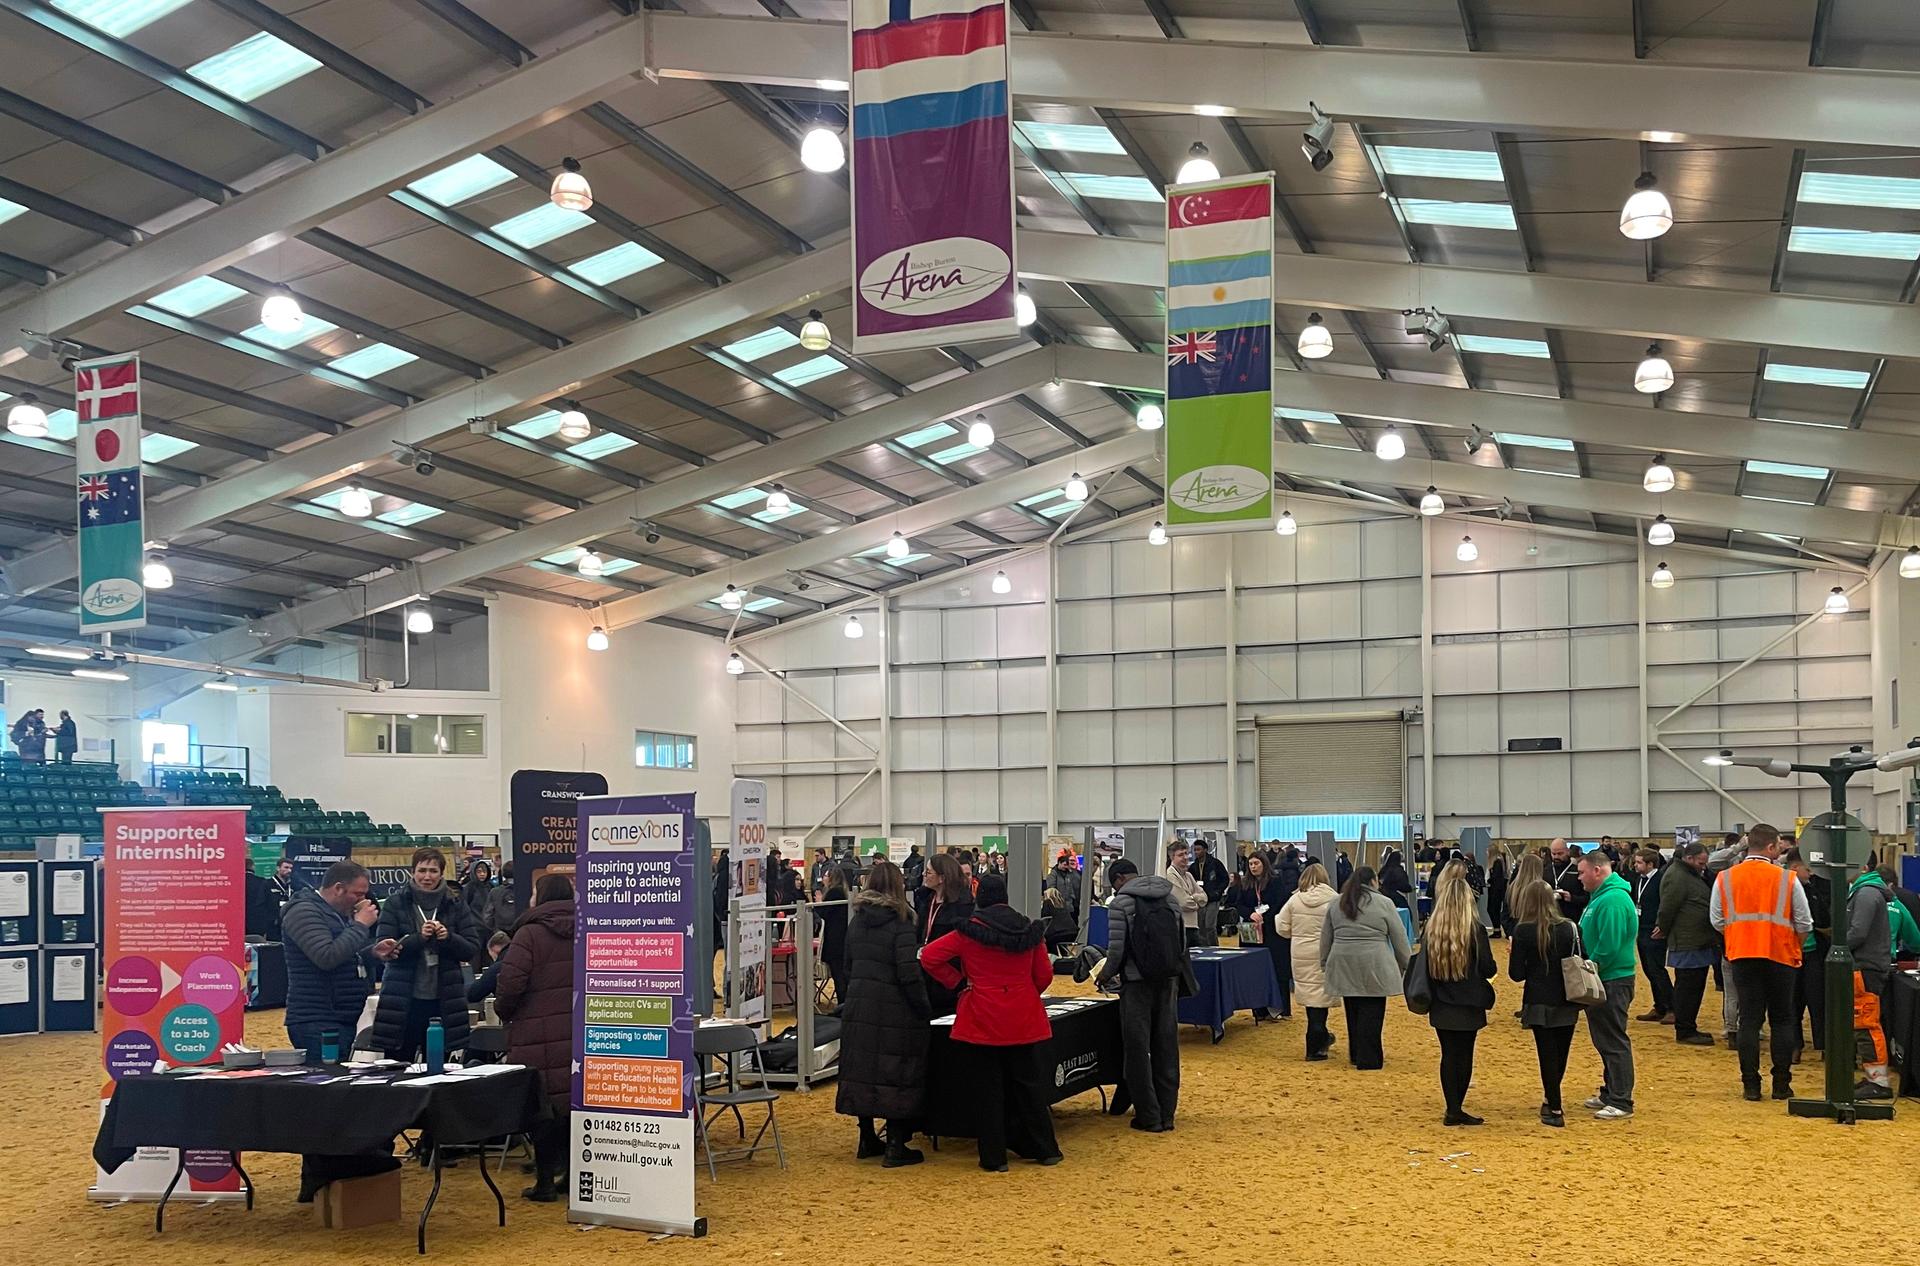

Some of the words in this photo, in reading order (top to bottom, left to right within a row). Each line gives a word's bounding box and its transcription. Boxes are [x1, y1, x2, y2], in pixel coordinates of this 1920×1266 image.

[910, 261, 933, 270] Bishop
[934, 256, 956, 266] Burton
[881, 252, 967, 302] Arena
[1183, 472, 1240, 503] Arena
[541, 790, 584, 799] CRANSWICK
[542, 816, 578, 828] CREAT
[116, 824, 218, 844] Supported
[591, 820, 679, 845] connexions
[739, 824, 765, 846] FOOD
[116, 844, 225, 863] Internships
[522, 842, 577, 854] OPPORTU
[588, 860, 634, 875] Inspiring
[637, 861, 670, 874] young
[370, 868, 414, 884] URTON
[587, 877, 622, 891] people
[626, 876, 636, 887] to
[639, 875, 681, 887] achieve
[587, 892, 611, 903] their
[613, 890, 631, 903] full
[634, 890, 681, 905] potential
[587, 918, 597, 926] We
[612, 918, 641, 927] support
[642, 919, 656, 927] you
[657, 917, 676, 925] with:
[590, 937, 634, 947] Information,
[635, 937, 658, 946] advice
[660, 937, 674, 946] and
[589, 947, 622, 957] guidance
[624, 947, 644, 956] about
[645, 948, 673, 958] post-16
[589, 958, 638, 968] opportunities
[589, 978, 636, 987] Personalised
[638, 978, 649, 987] 1-1
[651, 978, 680, 989] support
[588, 999, 613, 1008] Advice
[615, 1000, 635, 1008] about
[636, 1000, 652, 1009] CVs
[653, 1000, 666, 1009] and
[588, 1009, 633, 1019] applications
[173, 1017, 208, 1025] Access
[171, 1030, 182, 1038] to
[191, 1030, 210, 1038] Job
[588, 1030, 632, 1042] Signposting
[634, 1032, 641, 1040] to
[642, 1032, 662, 1041] other
[174, 1043, 206, 1052] Coach
[588, 1041, 621, 1050] agencies
[587, 1061, 629, 1073] Supporting
[630, 1064, 652, 1074] young
[653, 1064, 677, 1074] people
[1063, 1057, 1077, 1071] EAST
[587, 1072, 600, 1080] with
[614, 1073, 650, 1082] Education
[652, 1074, 677, 1084] Health
[587, 1082, 600, 1091] and
[602, 1082, 619, 1092] Care
[621, 1084, 638, 1092] Plan
[648, 1085, 657, 1094] be
[658, 1086, 679, 1095] better
[587, 1094, 620, 1104] prepared
[634, 1096, 672, 1105] adulthood
[594, 1120, 622, 1132] 01482
[624, 1122, 641, 1133] 615
[644, 1123, 660, 1134] 223
[594, 1136, 680, 1150] connexions@hullcc.gov.uk
[594, 1152, 673, 1167] www.hull.gov.uk
[595, 1176, 618, 1190] Hull
[595, 1194, 607, 1202] City
[608, 1195, 630, 1204] Council
